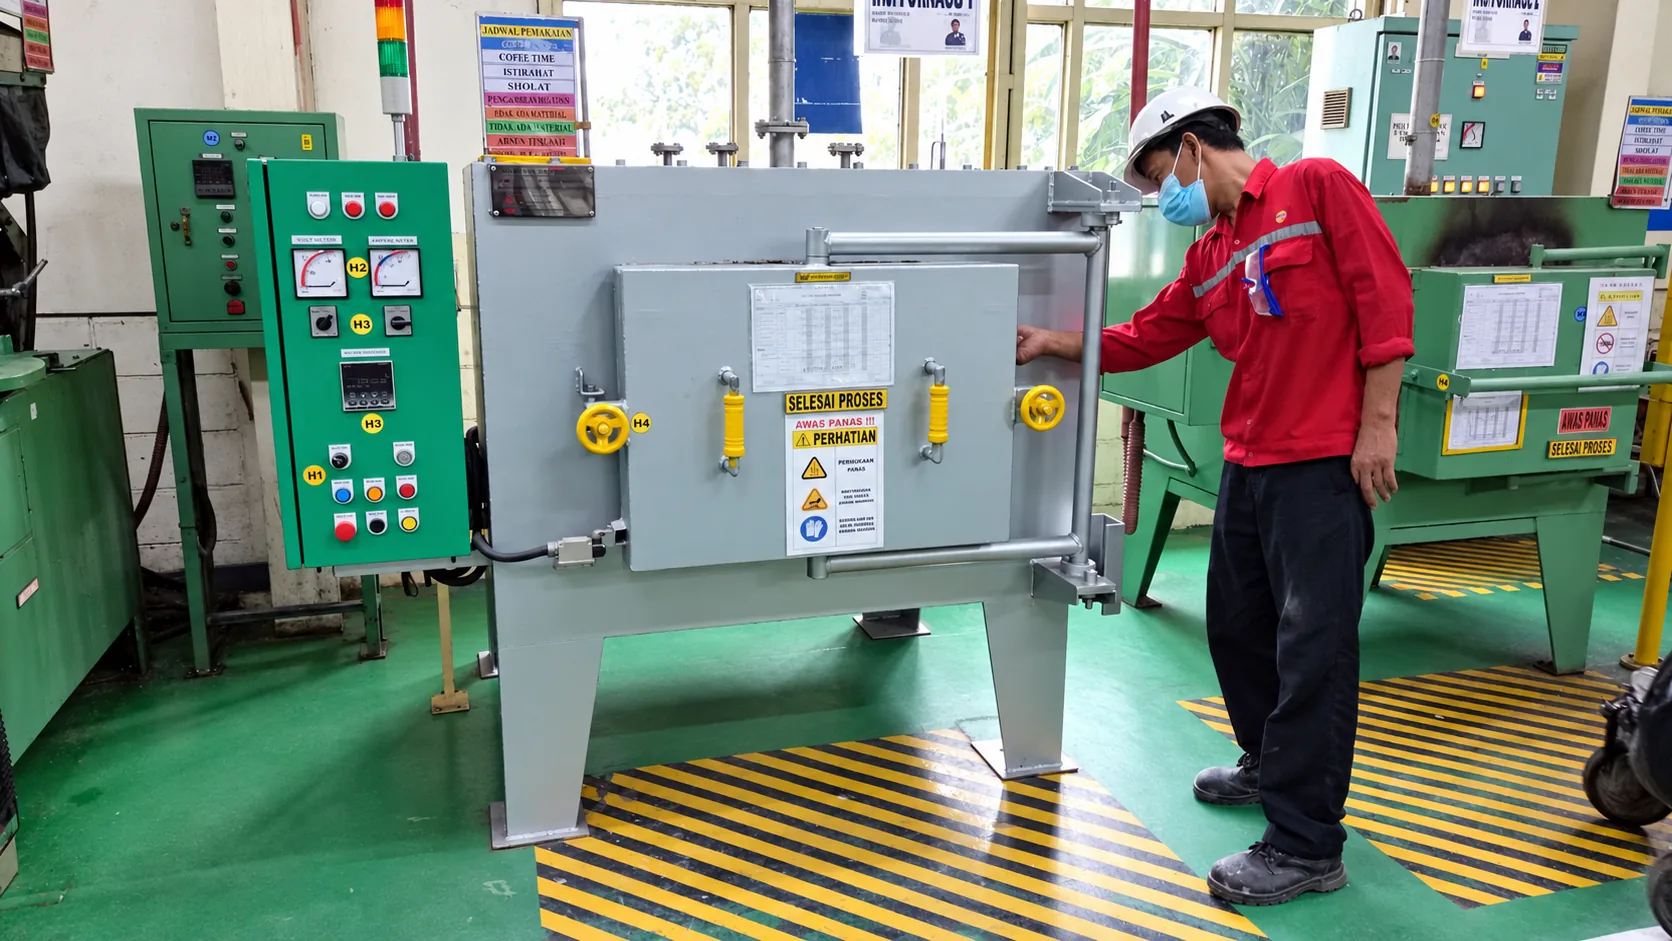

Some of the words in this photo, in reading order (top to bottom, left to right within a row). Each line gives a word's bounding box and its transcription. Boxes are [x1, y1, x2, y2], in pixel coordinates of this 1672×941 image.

[482, 26, 520, 36] JADWAL
[521, 27, 572, 38] PEMAKAIAN
[532, 54, 555, 63] TIME
[503, 68, 554, 77] ISTIRAHAT
[507, 82, 551, 91] SHOLAT
[349, 263, 367, 272] H2
[353, 320, 371, 329] H3
[788, 392, 835, 411] SELESAI
[839, 391, 883, 408] PROSES
[365, 419, 382, 428] H3
[633, 418, 650, 428] H4
[795, 419, 825, 429] AWAS
[828, 417, 863, 428] PANAS
[1561, 411, 1583, 430] AWAS
[1584, 410, 1608, 429] PANAS
[813, 430, 876, 446] PERHATIAN
[1551, 441, 1582, 456] SELESAI
[1582, 440, 1613, 454] PROSES
[307, 471, 323, 480] H1
